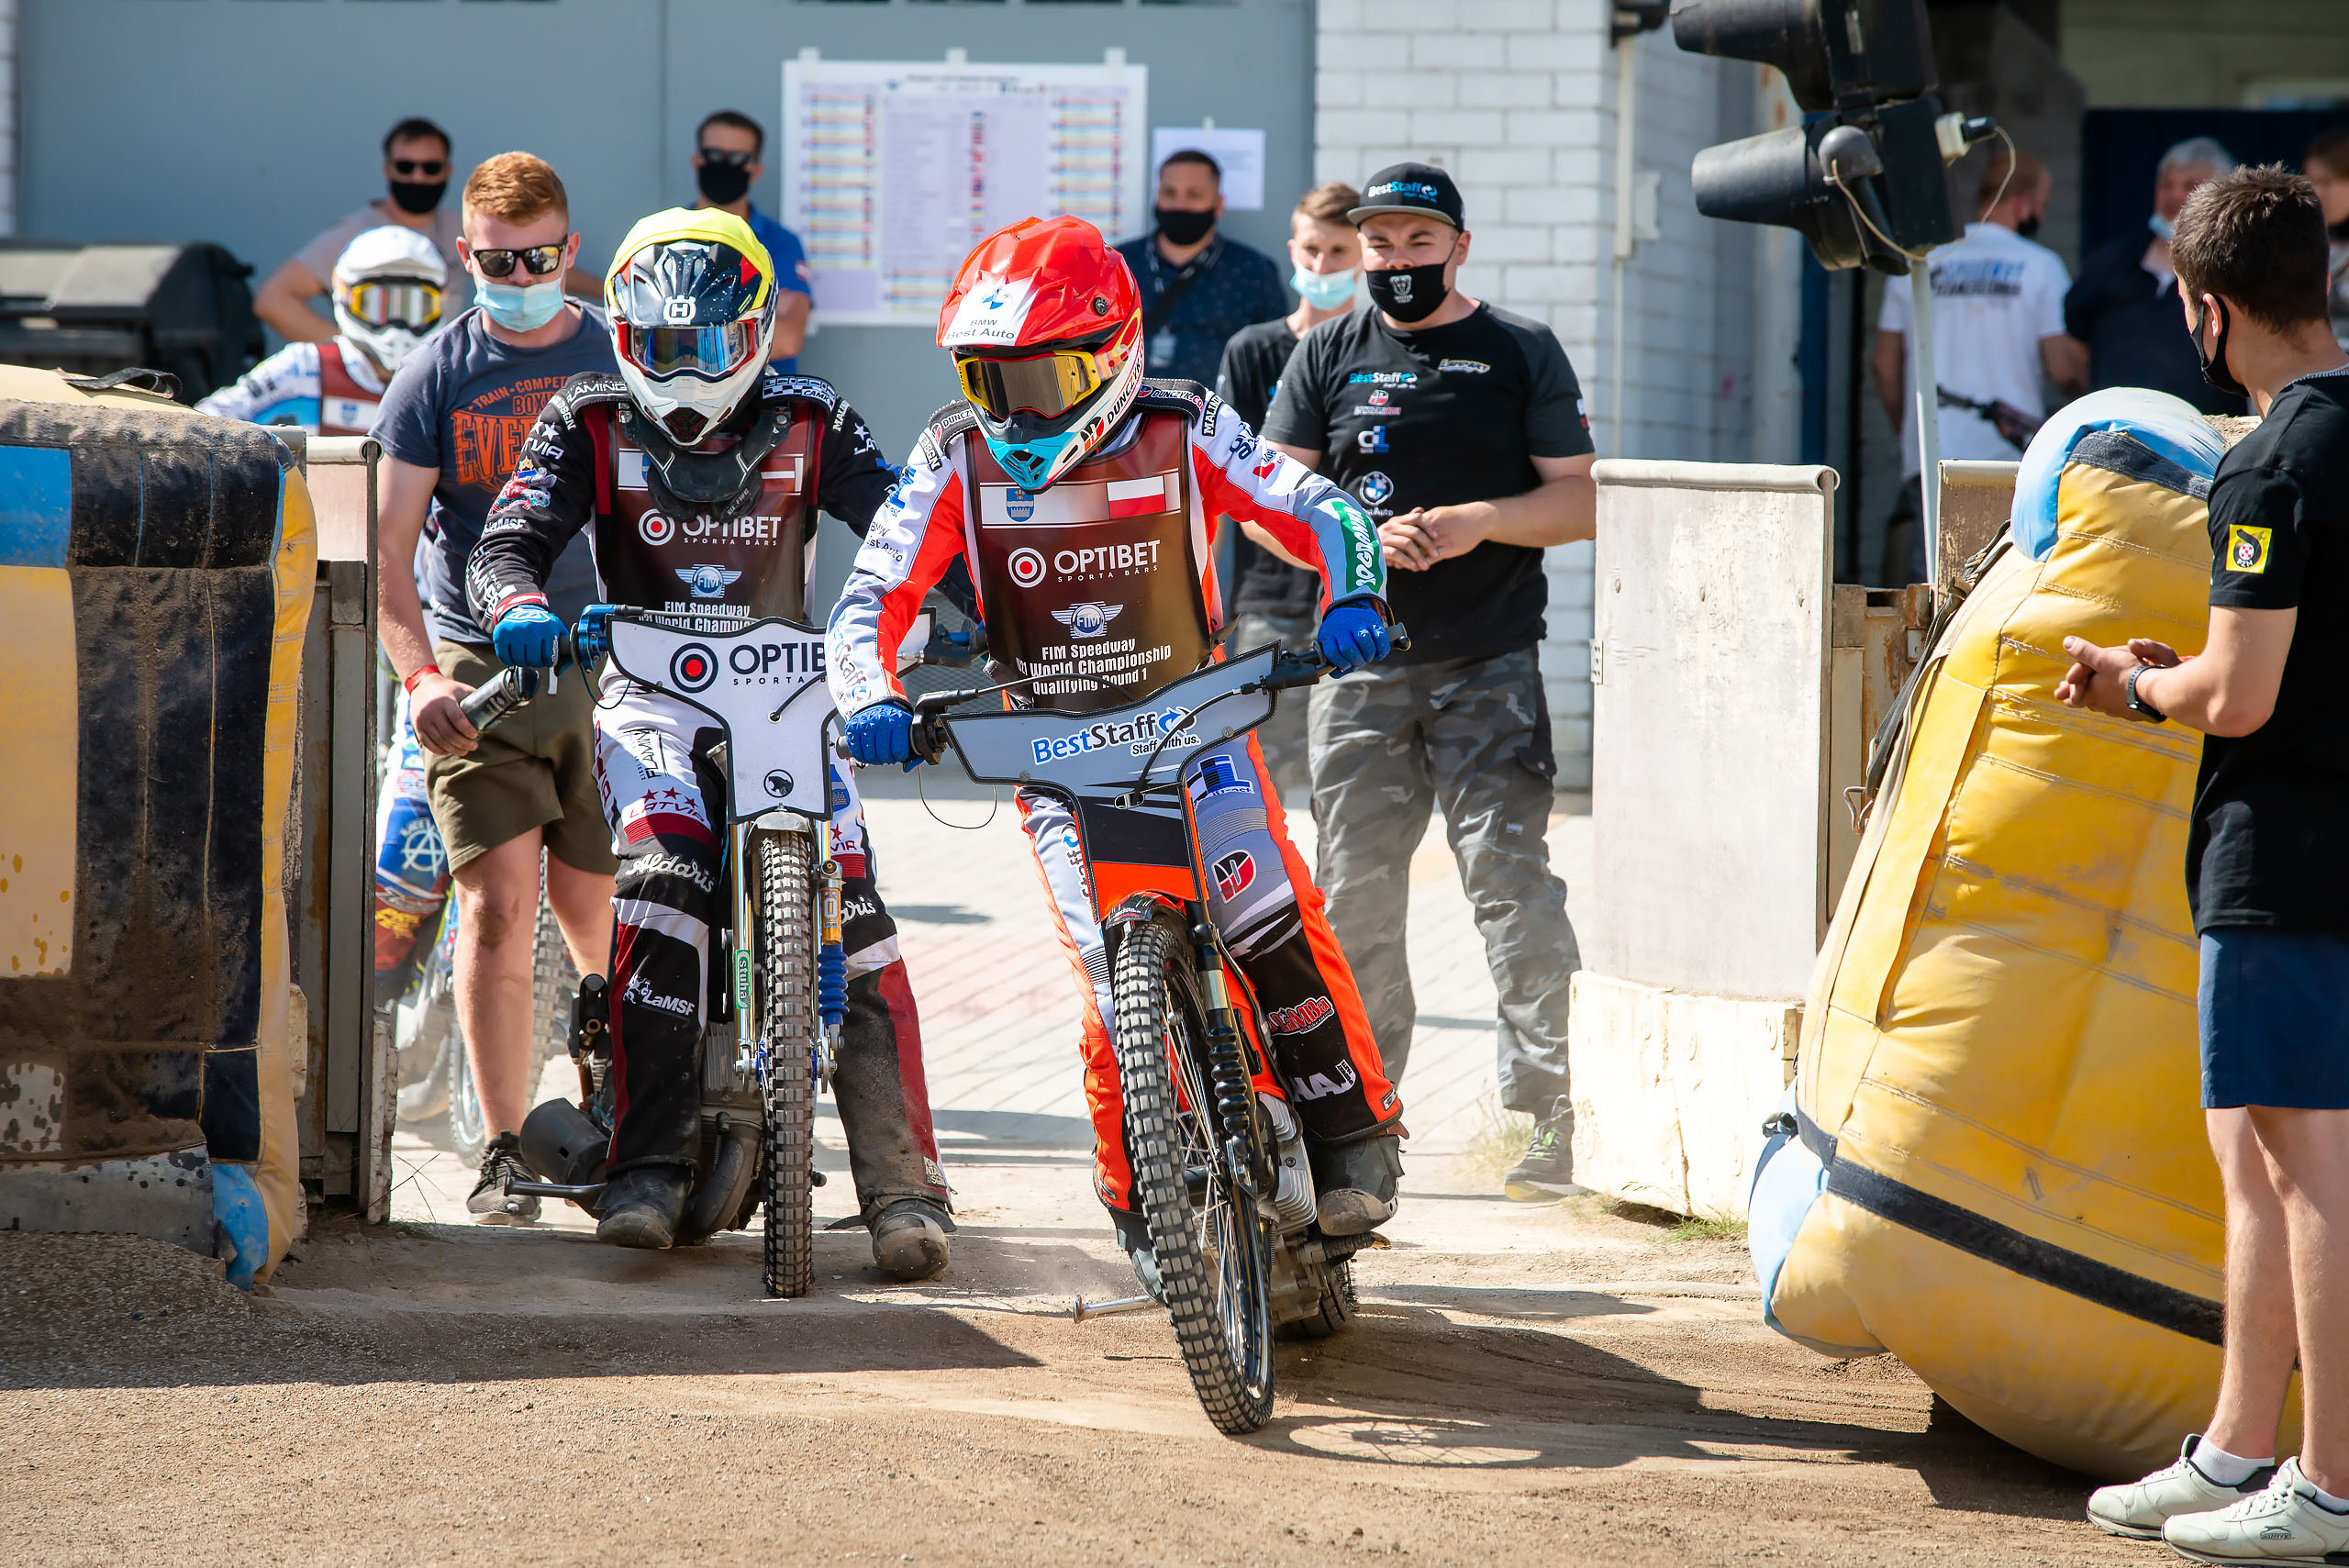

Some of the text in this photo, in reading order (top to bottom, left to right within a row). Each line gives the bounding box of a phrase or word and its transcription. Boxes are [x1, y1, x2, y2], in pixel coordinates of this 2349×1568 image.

[947, 328, 1015, 339] Best Auto
[1349, 372, 1402, 384] BestStaff
[473, 386, 510, 409] TRAIN
[515, 376, 571, 393] COMPET
[684, 537, 735, 546] SPORTA
[882, 542, 903, 562] Auto
[1054, 539, 1161, 573] OPTIBET
[696, 577, 720, 588] FIM
[1058, 572, 1113, 583] SPORTA
[664, 601, 751, 618] FIM Speedway
[1076, 616, 1100, 629] FIM
[729, 643, 826, 675] OPTIB
[1041, 638, 1136, 661] FIM Speedway
[1030, 660, 1074, 678] World
[1078, 644, 1172, 675] Championship
[734, 676, 805, 686] SPORTA
[1033, 676, 1098, 695] Qualifying
[1141, 670, 1148, 681] 1
[1033, 712, 1157, 764] BestStaff
[1132, 740, 1158, 755] Staff
[1185, 736, 1199, 745] us.
[630, 801, 705, 822] LATVIA
[830, 840, 857, 852] VIA
[629, 853, 715, 895] Aldaris
[841, 897, 875, 925] aris
[739, 960, 750, 999] stuha
[642, 990, 696, 1016] LaMSF
